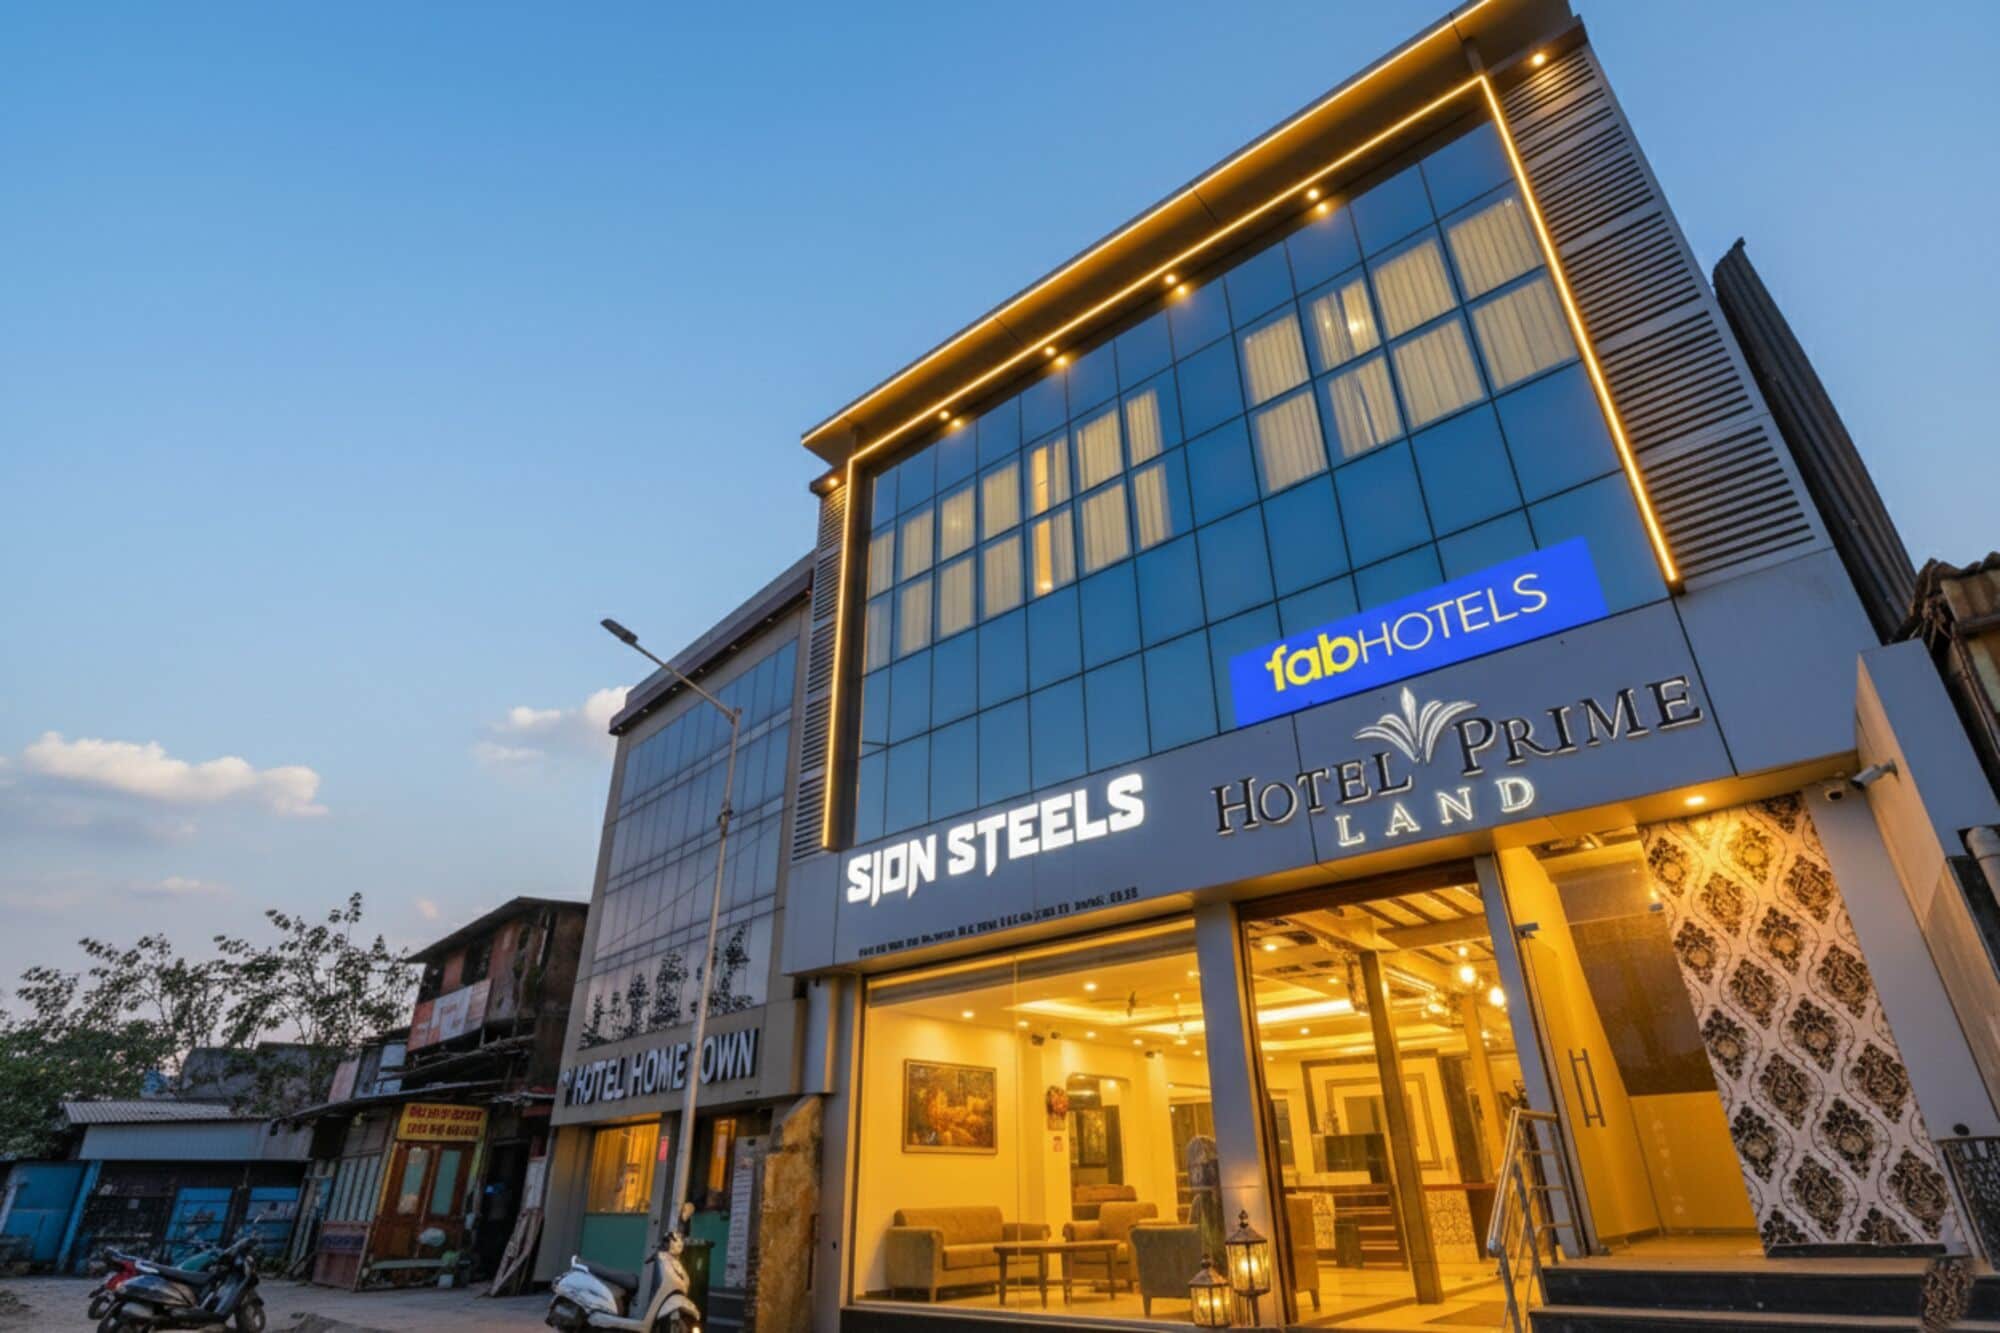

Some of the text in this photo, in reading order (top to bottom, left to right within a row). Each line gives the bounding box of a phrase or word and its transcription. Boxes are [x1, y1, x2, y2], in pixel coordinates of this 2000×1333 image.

[1265, 573, 1548, 691] fabHOTELS
[1211, 675, 1703, 835] HOTEL PRIME
[1335, 777, 1535, 847] LAND
[847, 773, 1145, 907] SION STEELS
[571, 1029, 759, 1105] HOTEL HOMEOWN
